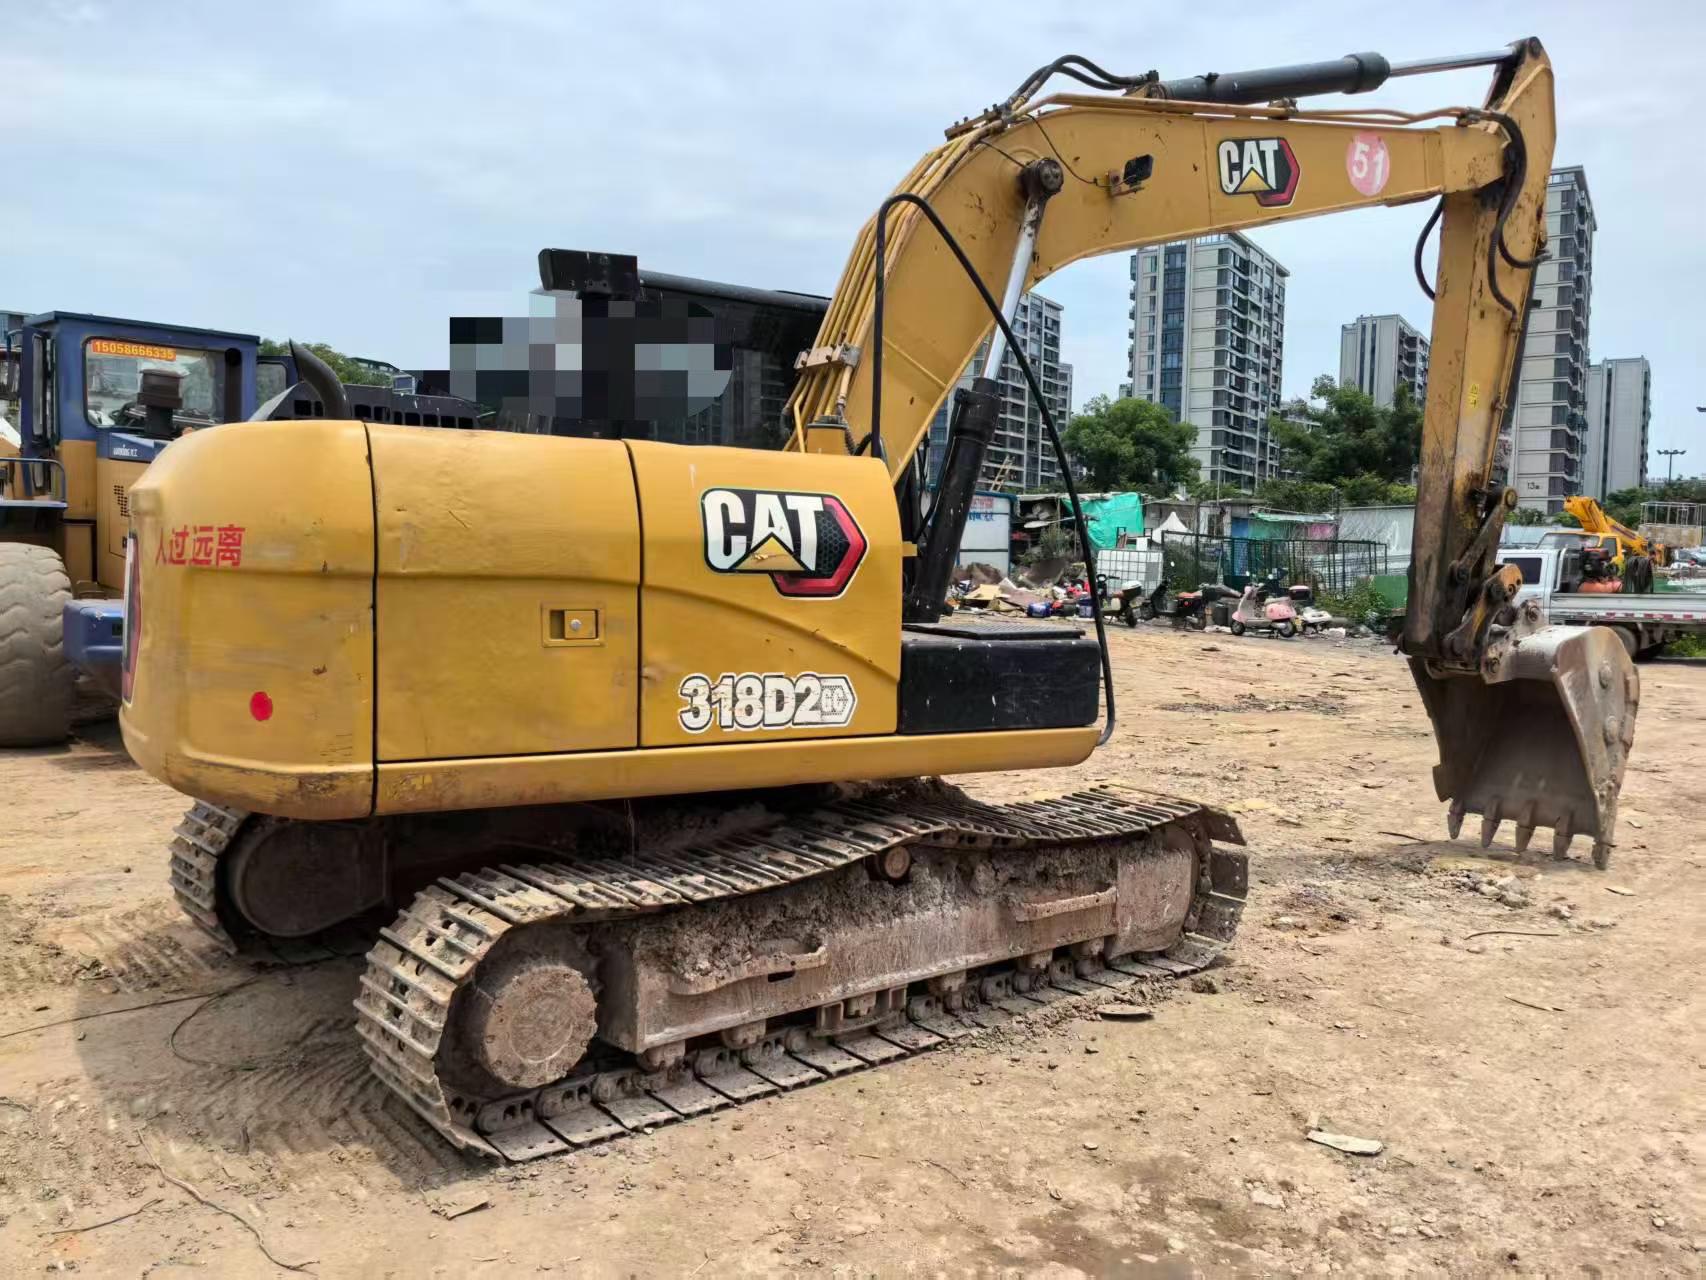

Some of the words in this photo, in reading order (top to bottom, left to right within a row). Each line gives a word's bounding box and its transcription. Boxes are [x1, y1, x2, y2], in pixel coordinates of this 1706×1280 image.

[1218, 138, 1278, 194] CAT
[1352, 142, 1386, 193] 51
[701, 489, 824, 571] CAT
[680, 674, 823, 730] 318D2
